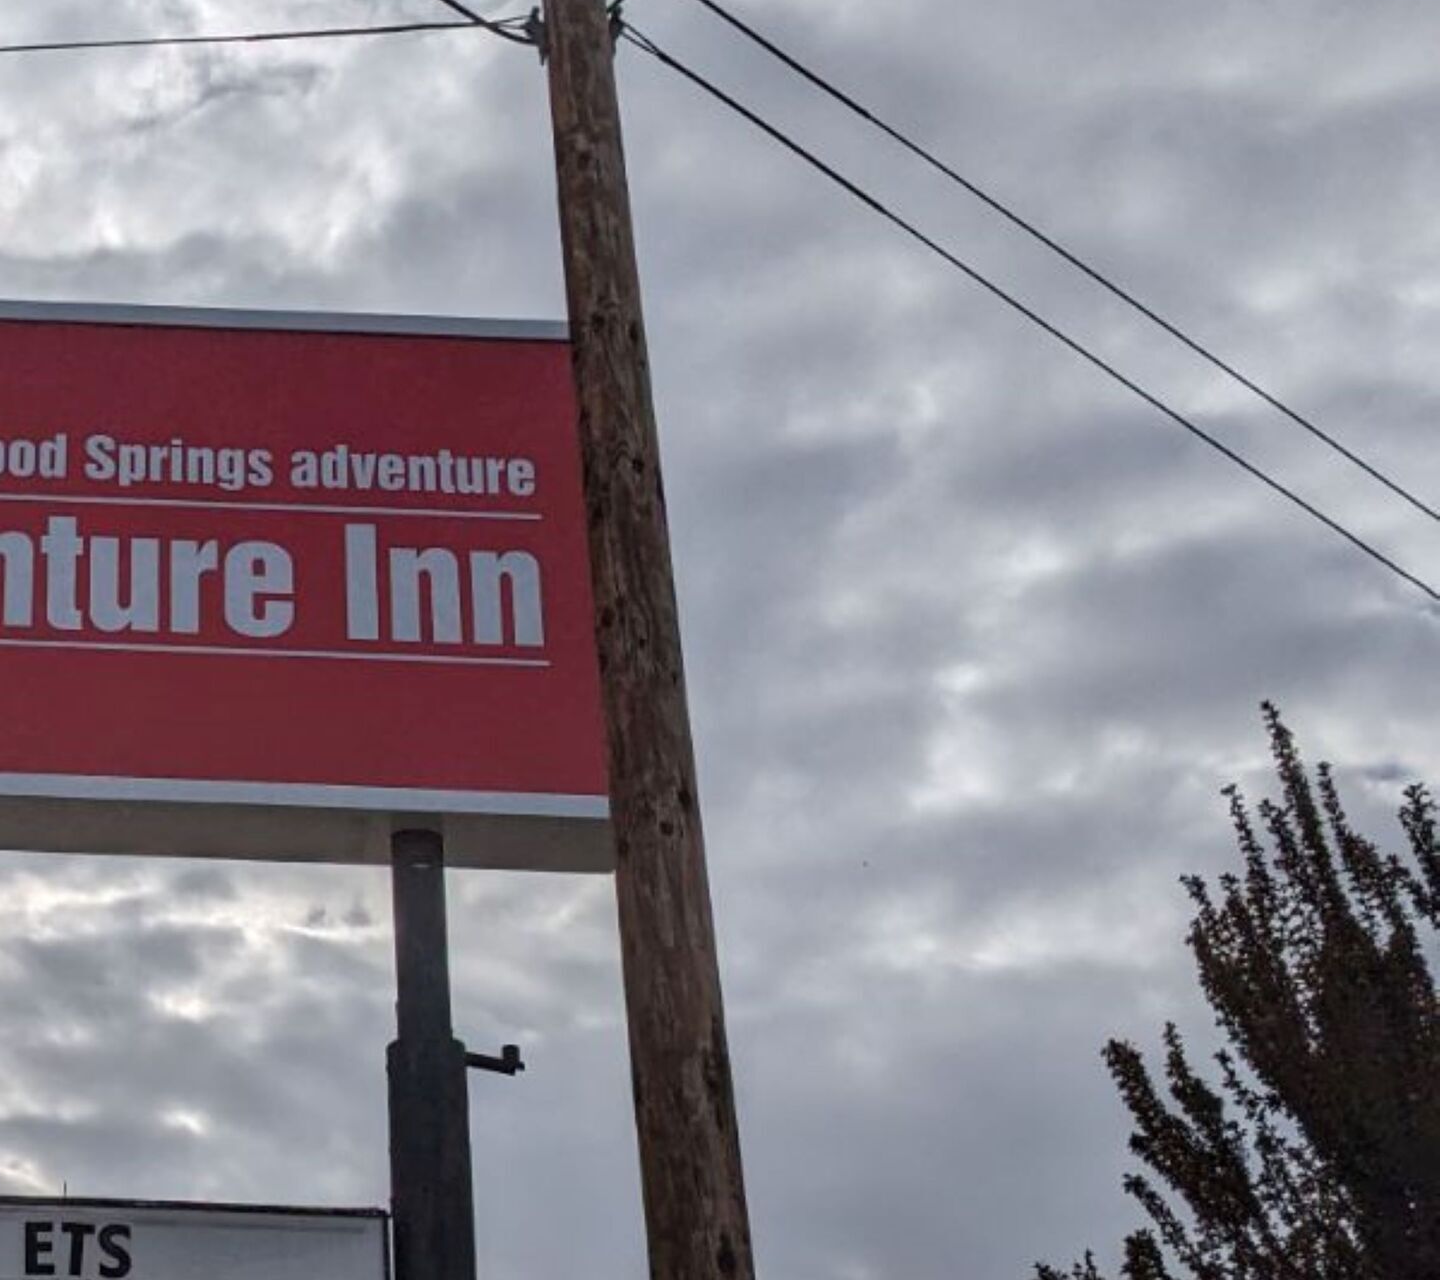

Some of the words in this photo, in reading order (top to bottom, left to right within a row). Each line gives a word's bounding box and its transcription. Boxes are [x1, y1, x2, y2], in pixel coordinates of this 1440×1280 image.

[85, 434, 272, 491] Springs
[290, 451, 535, 495] adventure
[346, 524, 546, 646] Inn
